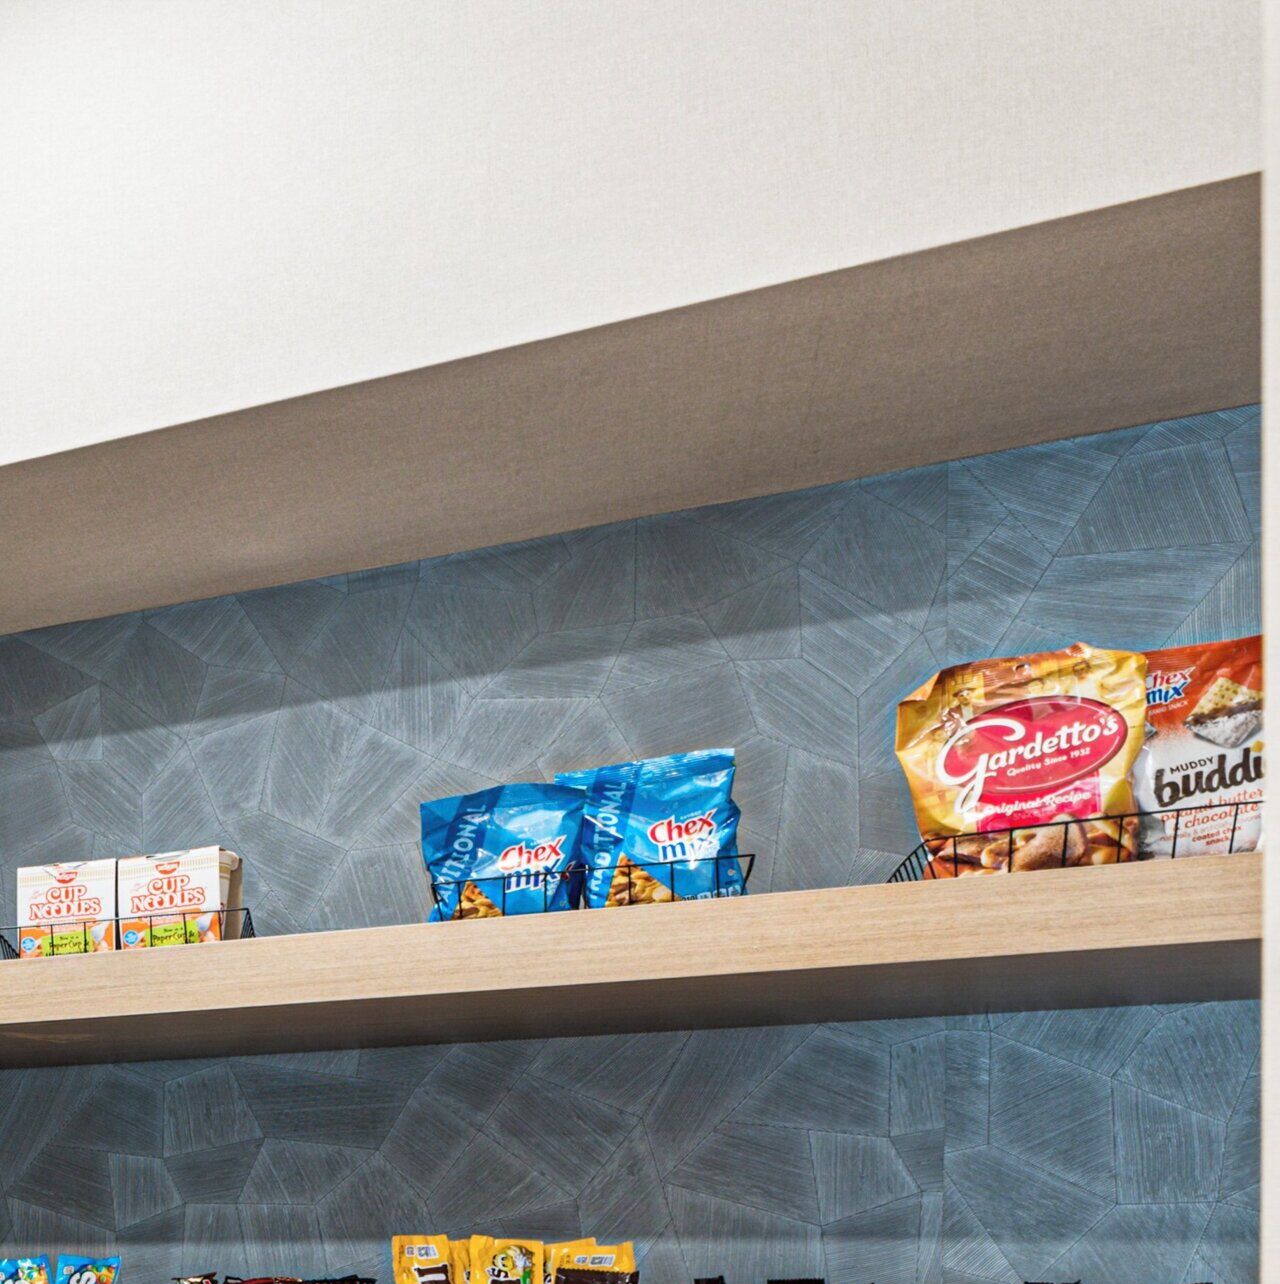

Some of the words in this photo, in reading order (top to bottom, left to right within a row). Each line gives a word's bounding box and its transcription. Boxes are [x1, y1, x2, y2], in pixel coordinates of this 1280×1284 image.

[935, 713, 1120, 815] Gardetto's
[1169, 755, 1215, 775] MUDDY
[648, 809, 718, 845] Chex
[500, 836, 567, 871] Chex
[45, 886, 88, 904] CUP
[147, 875, 191, 896] CUP
[29, 898, 102, 921] NOODLES
[130, 886, 206, 914] NOODLES
